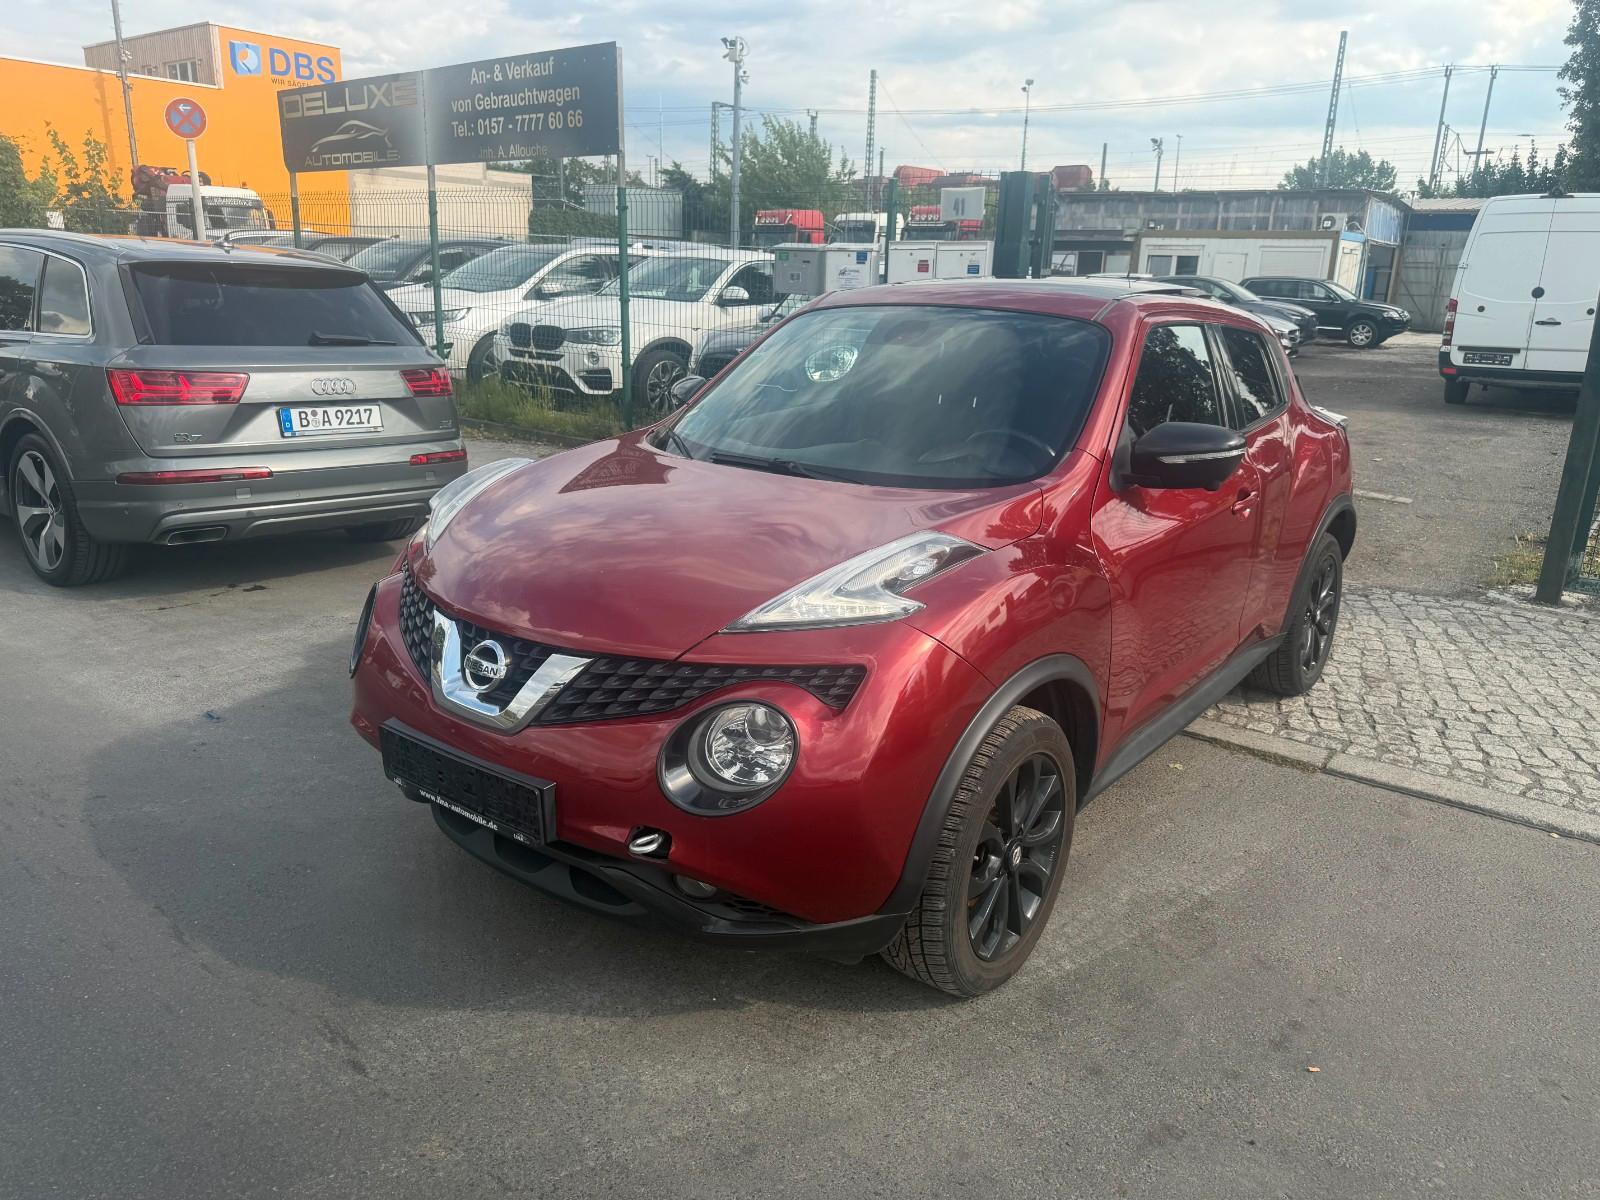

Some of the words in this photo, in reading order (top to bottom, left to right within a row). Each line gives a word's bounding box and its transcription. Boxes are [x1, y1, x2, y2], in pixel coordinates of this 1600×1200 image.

[269, 48, 336, 84] DBS
[470, 67, 491, 84] An-
[493, 64, 503, 81] &
[505, 56, 555, 80] Verkauf
[271, 77, 285, 86] WIR
[283, 79, 417, 119] DELUXE
[451, 98, 472, 113] von
[475, 86, 580, 110] Gebrauchtwagen
[451, 119, 475, 138] Tel.:
[477, 117, 504, 136] 0157
[515, 113, 544, 132] 7777
[548, 111, 563, 130] 60
[567, 109, 583, 128] 66
[304, 150, 400, 167] AUTOMOBILE
[498, 145, 507, 158] A.
[509, 143, 548, 158] Allouche
[299, 410, 311, 428] B
[322, 409, 332, 427] A
[335, 408, 373, 426] 9217
[466, 656, 499, 676] NISSAN
